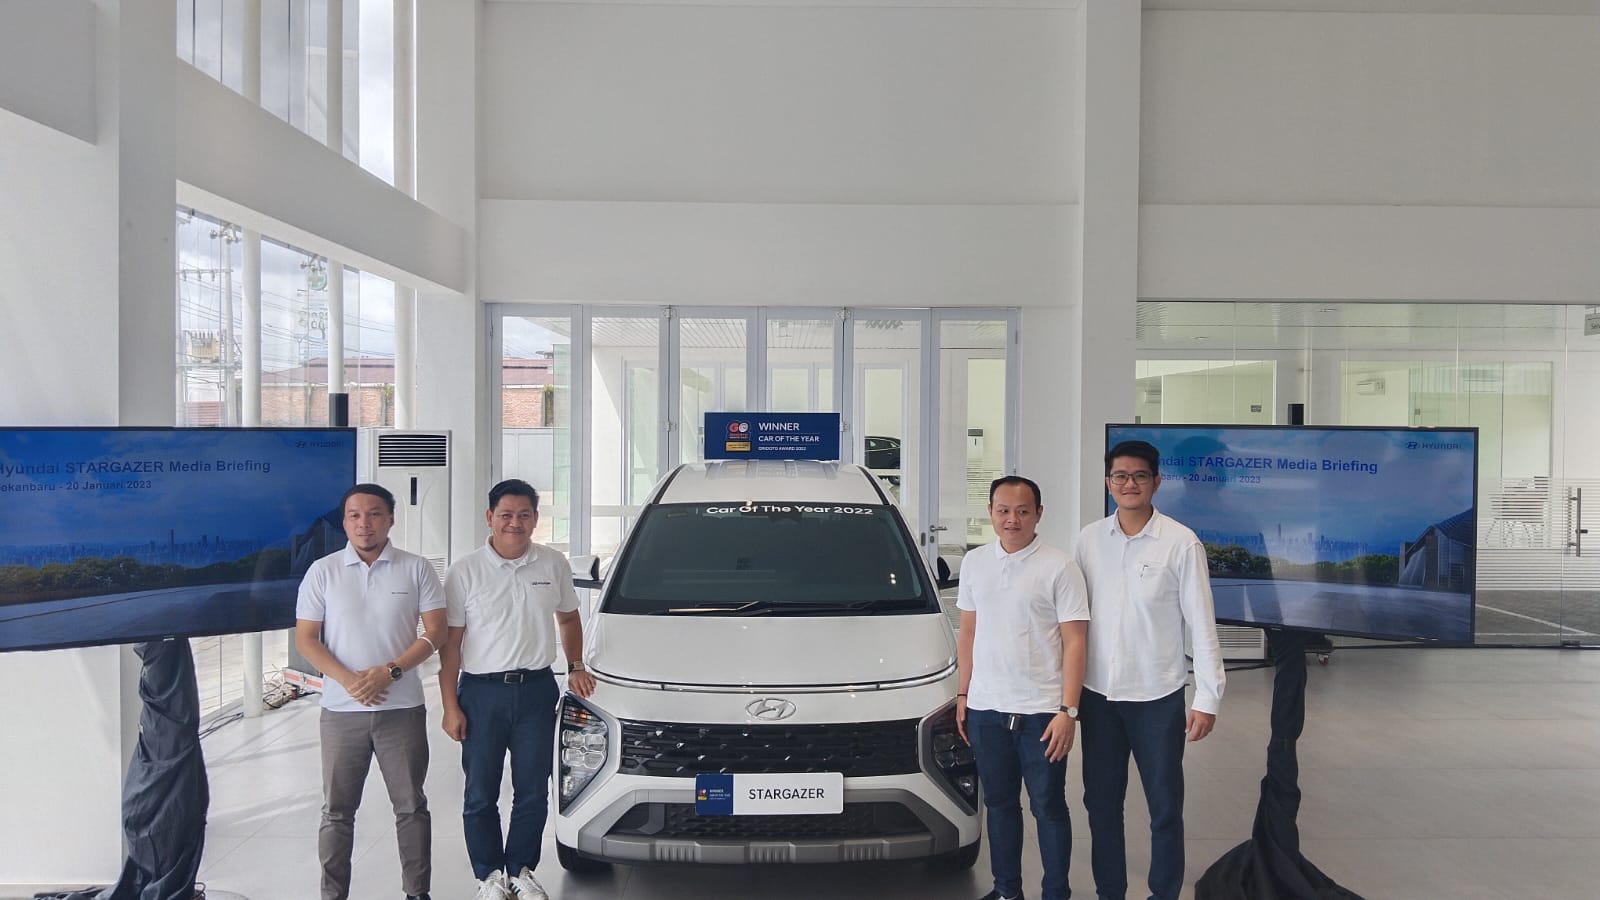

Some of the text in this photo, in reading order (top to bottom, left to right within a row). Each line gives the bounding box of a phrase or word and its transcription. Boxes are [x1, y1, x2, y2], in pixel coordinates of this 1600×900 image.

[758, 422, 800, 431] WINNER
[65, 461, 164, 474] STARGAZER
[169, 460, 211, 472] Media
[216, 460, 271, 474] Briefing
[1188, 456, 1272, 469] STARGAZER
[1277, 458, 1317, 471] Media
[1322, 459, 1378, 475] Briefing
[1189, 473, 1200, 482] 20
[1239, 475, 1261, 484] 2023
[0, 482, 56, 493] ekanbaru
[66, 481, 79, 490] 20
[82, 480, 123, 490] Januari
[127, 480, 152, 489] 2023
[706, 504, 874, 515] Car Of The Year 2022
[748, 788, 825, 800] STARGAZER
